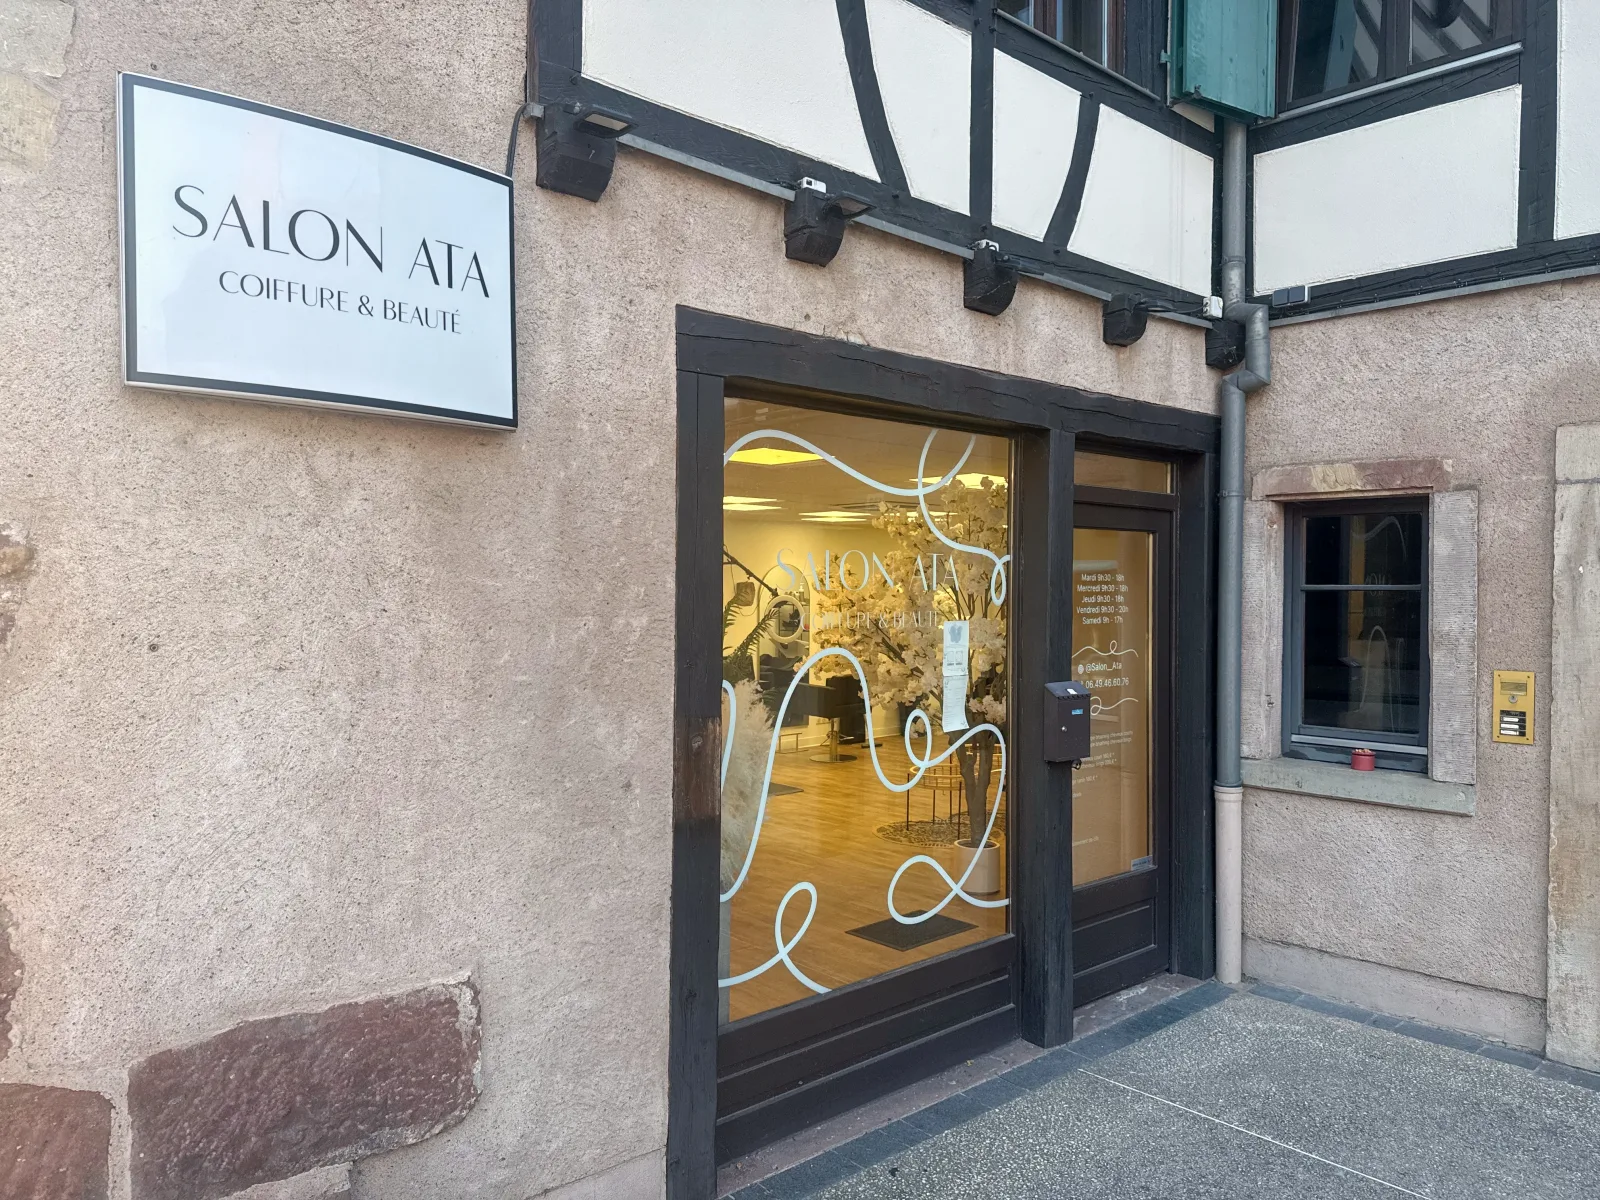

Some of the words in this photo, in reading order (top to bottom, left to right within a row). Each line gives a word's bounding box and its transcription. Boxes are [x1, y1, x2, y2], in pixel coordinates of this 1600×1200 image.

[171, 184, 384, 274] SALON
[408, 237, 490, 298] ATA
[218, 270, 349, 314] COIFFURE
[357, 294, 375, 318] &
[383, 299, 462, 335] BEAUTÉ
[776, 548, 894, 591] SALON
[909, 553, 959, 591] ATA
[1081, 573, 1096, 581] Mardi
[1097, 573, 1111, 581] 9h30
[1116, 573, 1125, 581] 18h
[1077, 584, 1100, 592] Mercredi
[1101, 584, 1115, 592] 9h30
[1120, 584, 1129, 592] 18h
[1081, 595, 1096, 603] Jeudi
[1096, 595, 1111, 603] 9h30
[1076, 605, 1100, 614] Vendredi
[1101, 605, 1115, 613] 9h30
[1119, 605, 1129, 613] 20h
[1082, 616, 1102, 625] Samedi
[1102, 616, 1110, 624] 9h
[1114, 615, 1124, 624] 17h
[1085, 677, 1129, 689] 06.49.46.60.76
